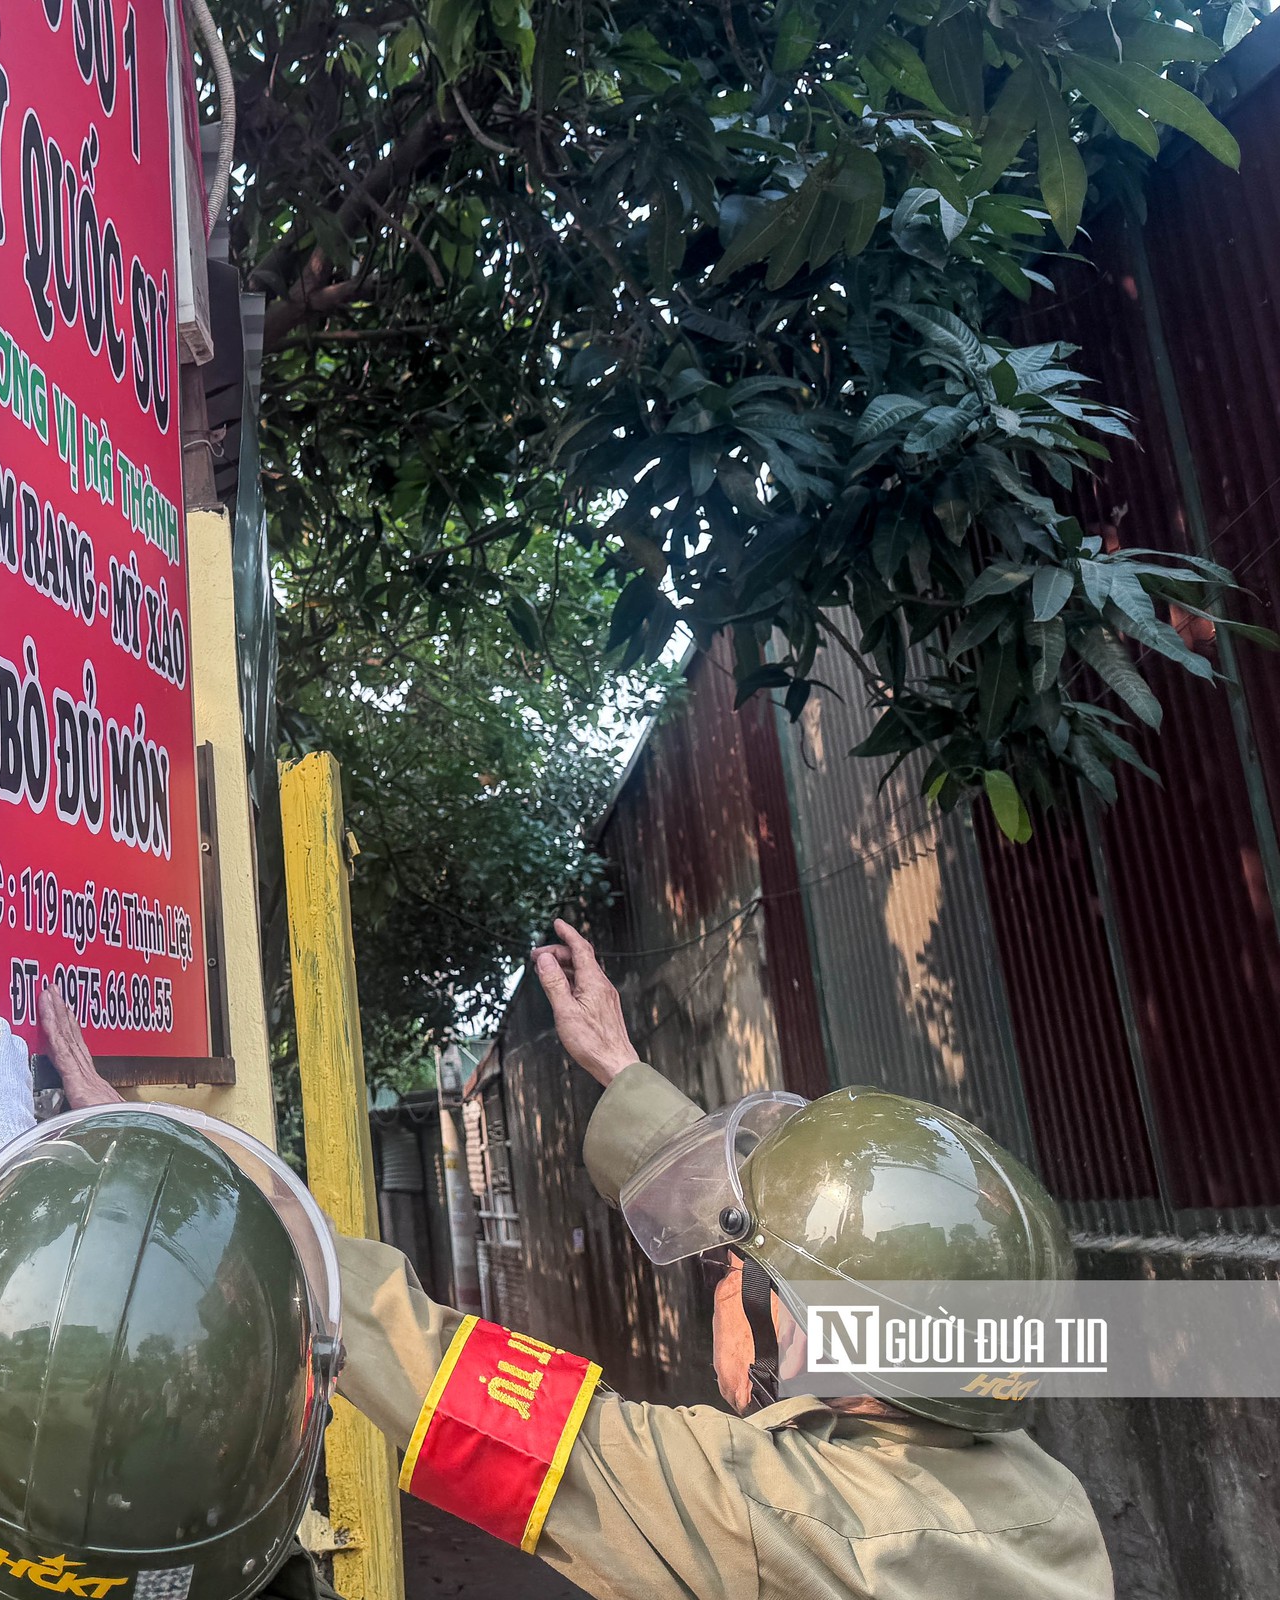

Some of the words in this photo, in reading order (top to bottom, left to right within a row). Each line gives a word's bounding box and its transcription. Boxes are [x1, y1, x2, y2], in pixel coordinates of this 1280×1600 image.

[123, 2, 140, 164] 1
[21, 107, 125, 383] QUỐC
[52, 382, 79, 494] VỊ
[82, 413, 115, 505] HÀ
[117, 449, 180, 566] THÀNH
[20, 481, 95, 626] RANG
[145, 576, 186, 690] XÀO
[53, 659, 105, 835] ĐỦ
[107, 703, 171, 862] MÓN
[20, 866, 58, 935] 119
[62, 880, 97, 956] ngõ
[100, 887, 122, 948] 42
[122, 892, 166, 964] Thịnh
[166, 905, 194, 972] Liệt
